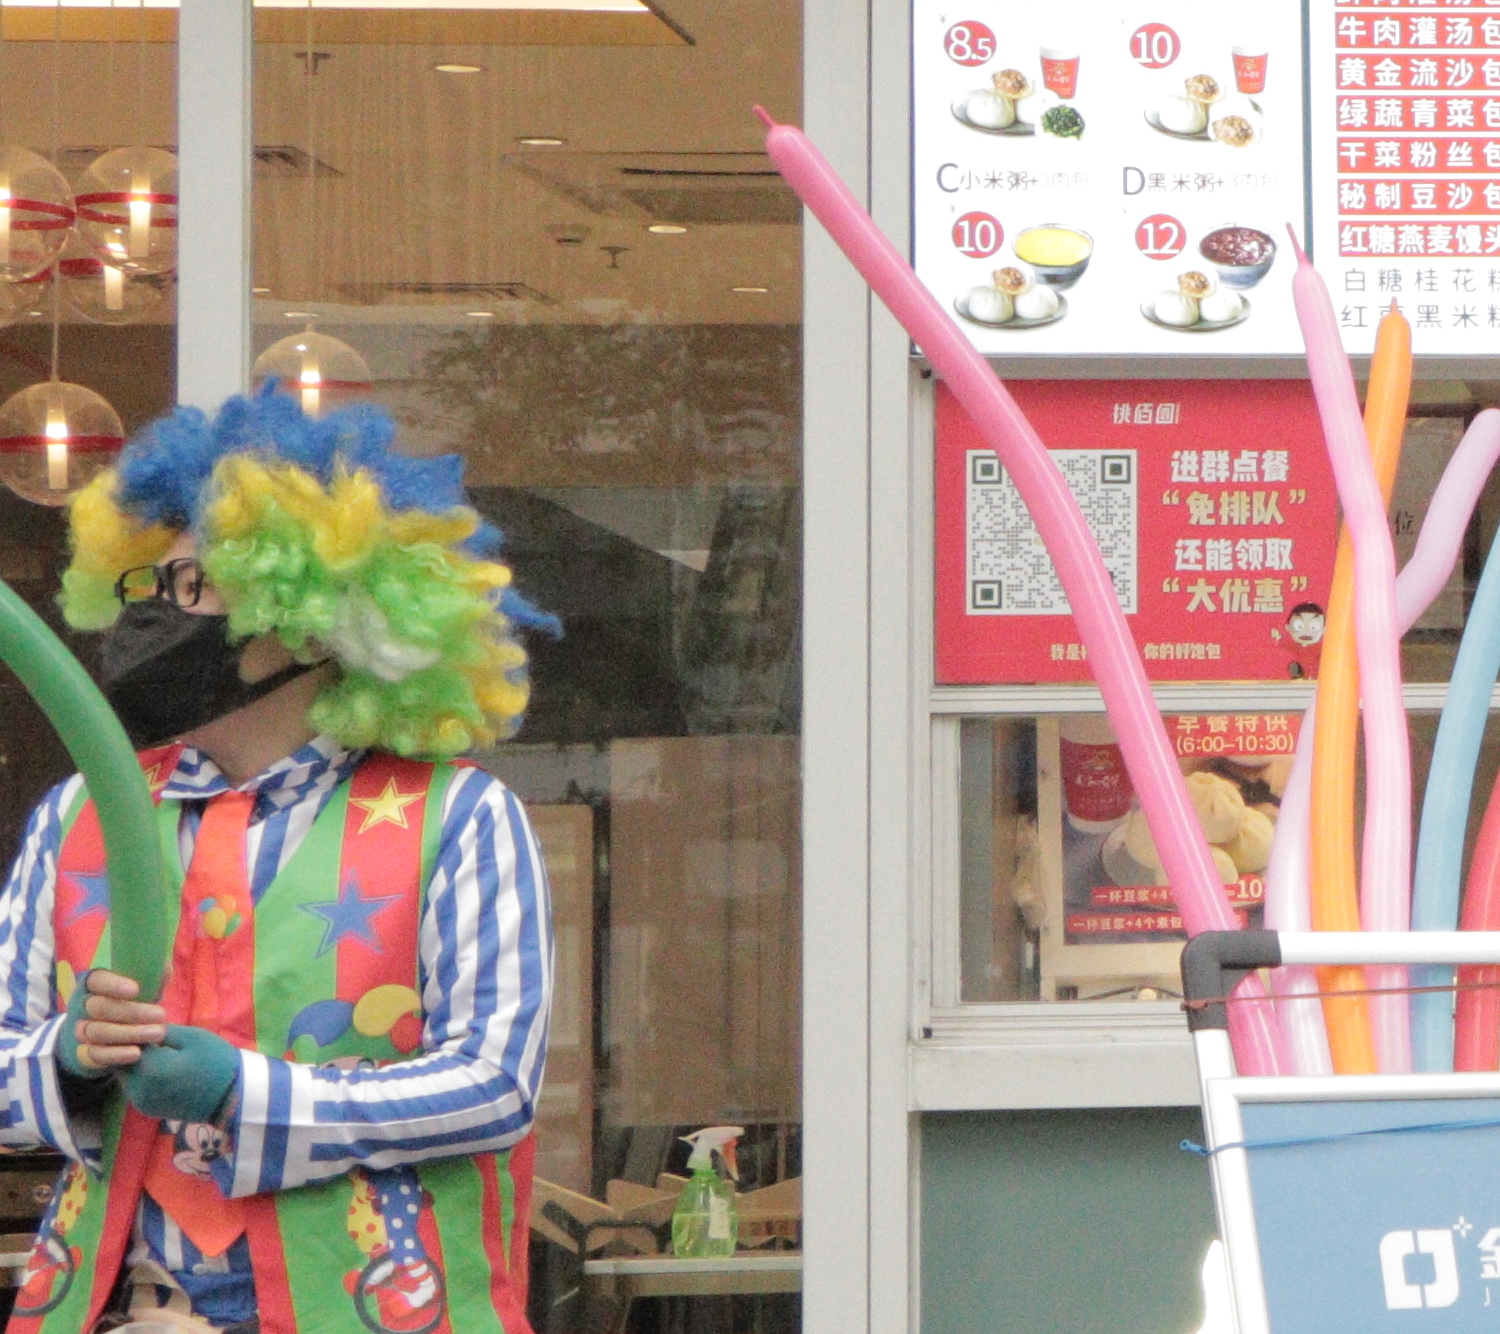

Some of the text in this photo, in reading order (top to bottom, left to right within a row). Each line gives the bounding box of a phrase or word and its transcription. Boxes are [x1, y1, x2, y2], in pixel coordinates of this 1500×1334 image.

[949, 26, 992, 61] 8.5
[1136, 31, 1173, 64] 10
[936, 162, 959, 193] C
[1123, 166, 1145, 196] D
[956, 220, 996, 252] 10
[1143, 223, 1180, 254] 12
[1171, 450, 1289, 482] 进群点餐
[1175, 539, 1293, 570] 还能领取
[1177, 715, 1288, 733] 早餐特供
